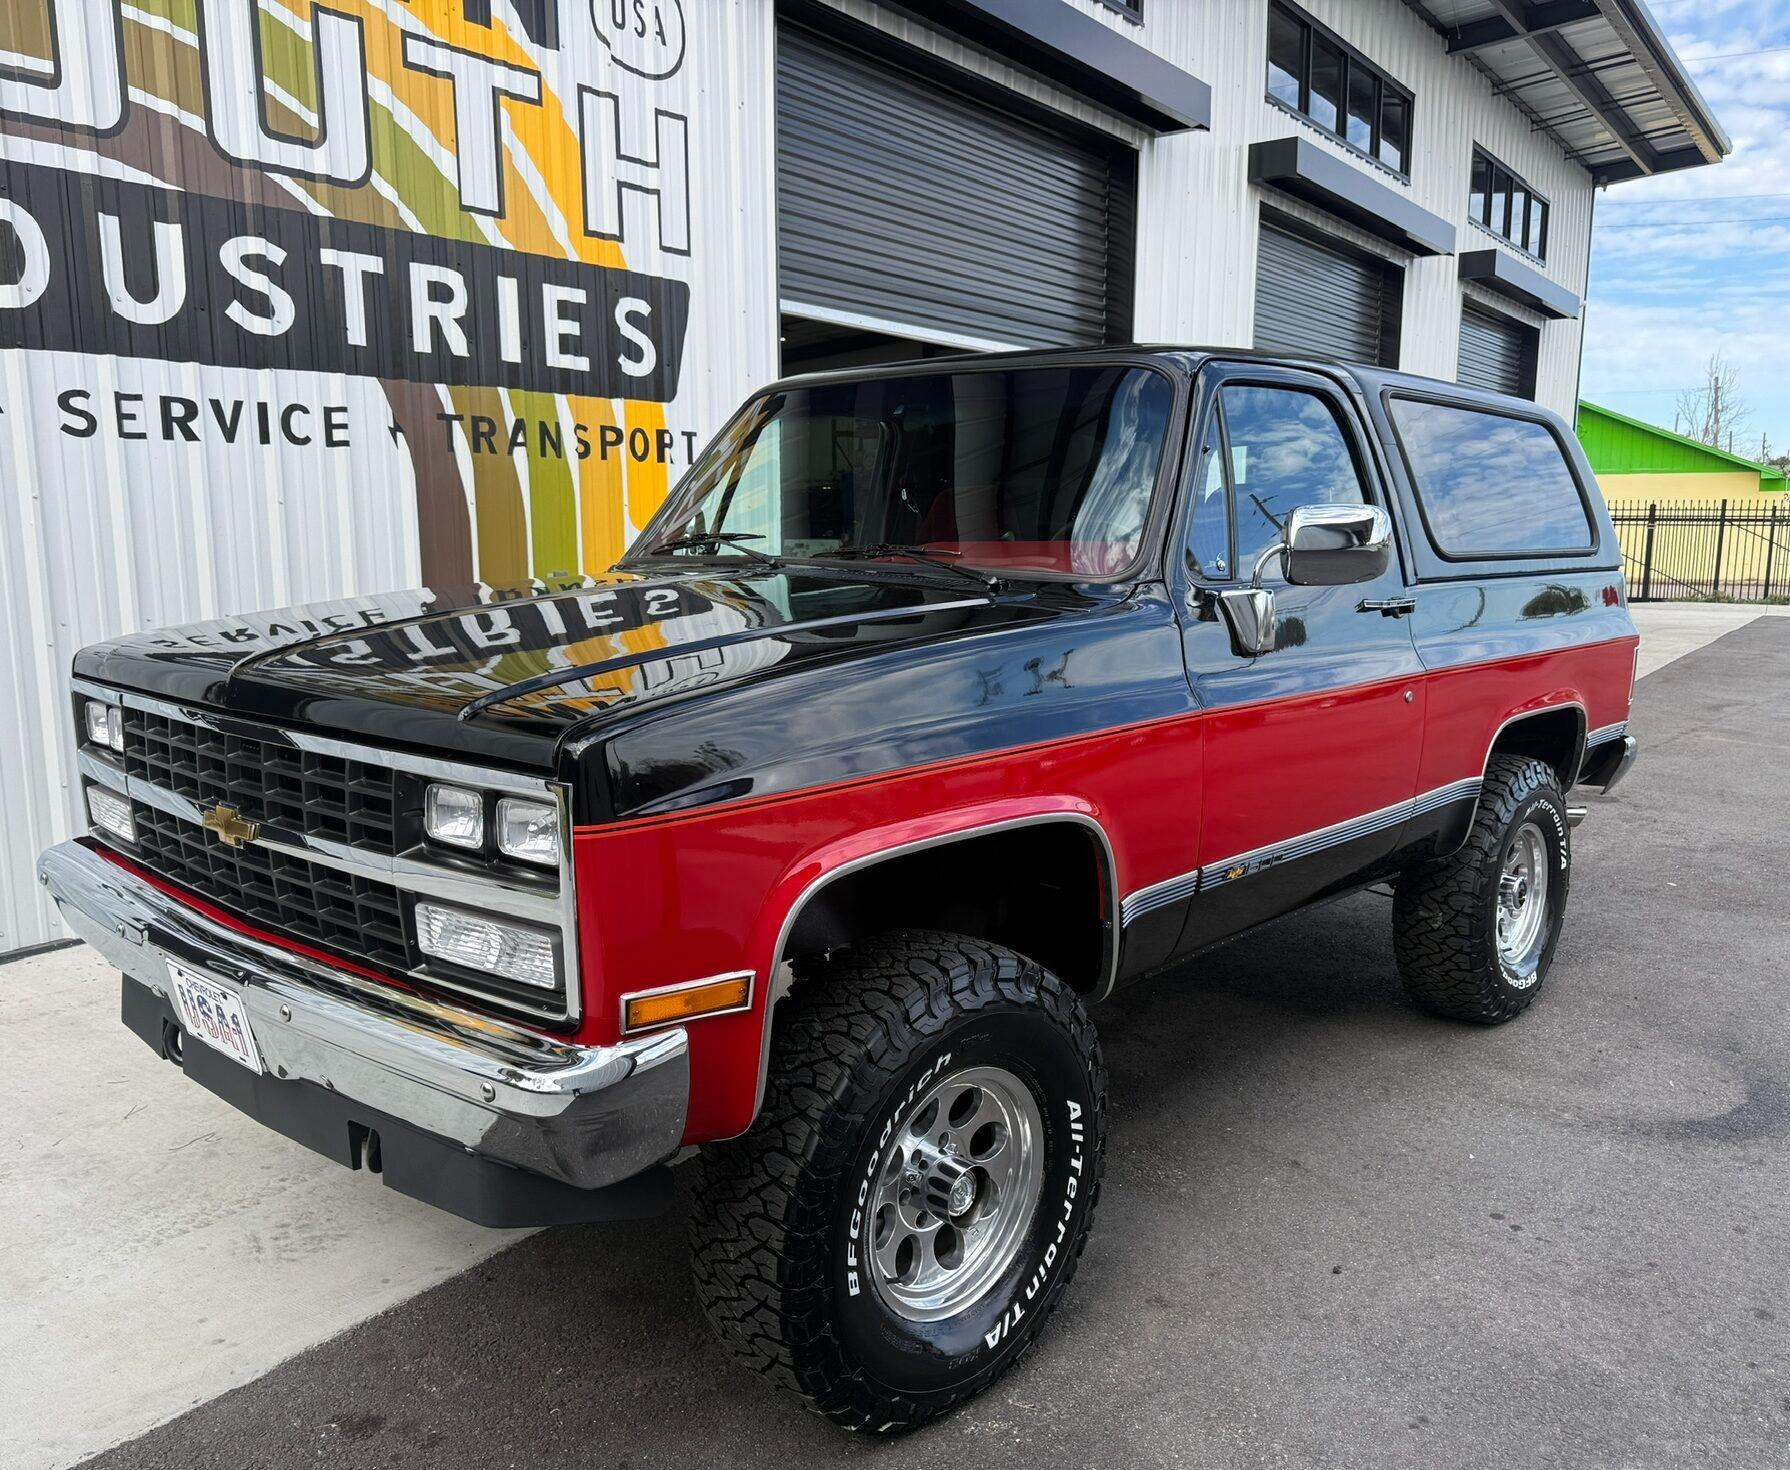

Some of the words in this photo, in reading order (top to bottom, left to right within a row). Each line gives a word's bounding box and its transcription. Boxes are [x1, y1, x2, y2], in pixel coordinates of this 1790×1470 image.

[612, 0, 667, 46] USA
[58, 389, 351, 448] SERVICE
[437, 413, 698, 465] TRANSPORT
[847, 1053, 952, 1296] BFGoodrich
[1025, 1100, 1085, 1300] All-Terrain
[984, 1302, 1025, 1349] T/A
